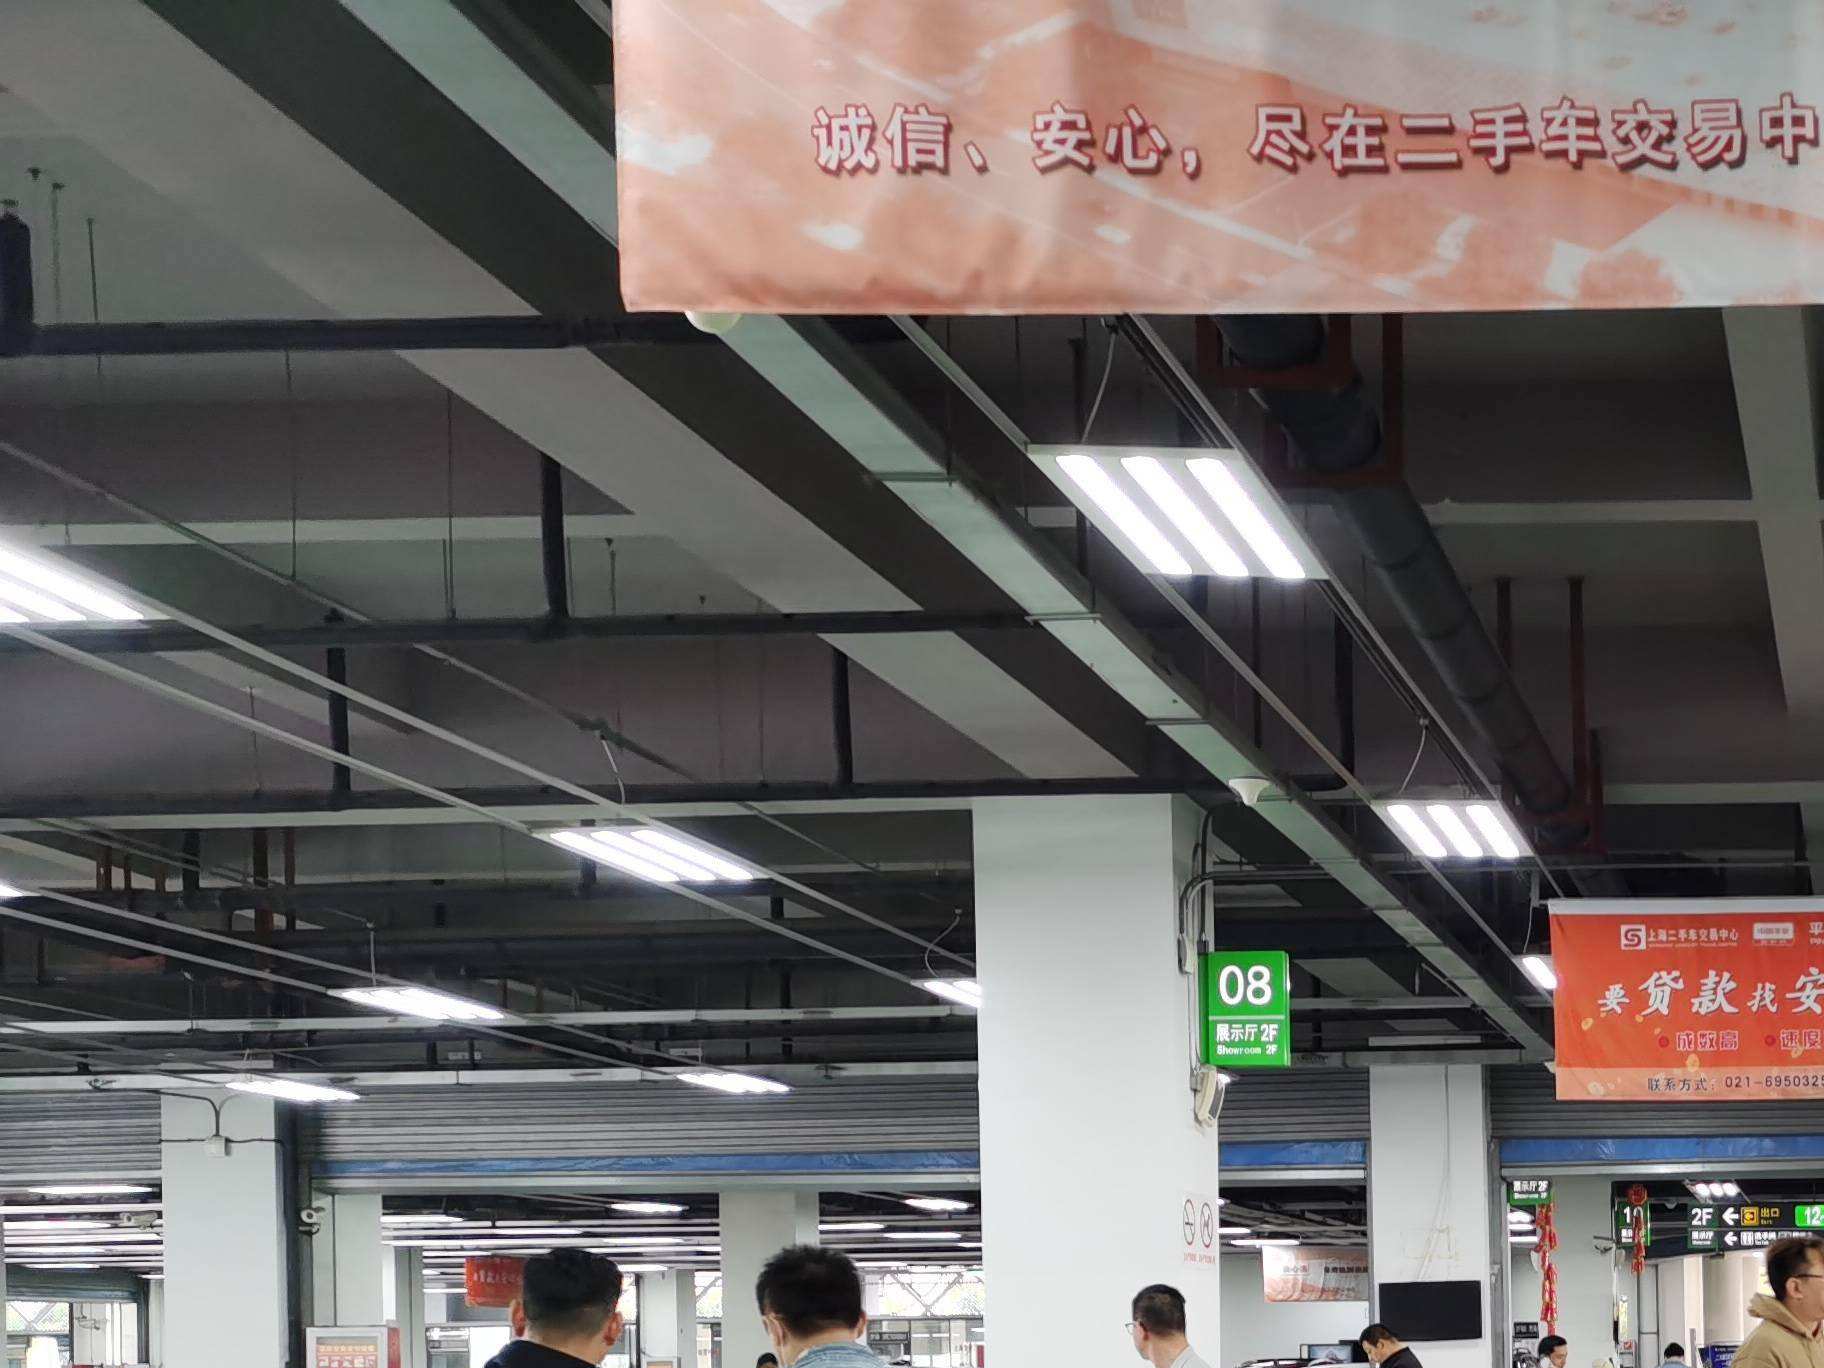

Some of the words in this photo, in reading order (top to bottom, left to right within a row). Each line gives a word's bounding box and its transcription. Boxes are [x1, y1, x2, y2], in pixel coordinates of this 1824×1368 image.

[1219, 965, 1272, 1005] 08
[1216, 1023, 1258, 1042] 展示厅
[1260, 1023, 1279, 1042] 2F
[1674, 1029, 1740, 1052] 成数高
[1216, 1045, 1262, 1056] Showroom
[1691, 1207, 1714, 1226] 2F
